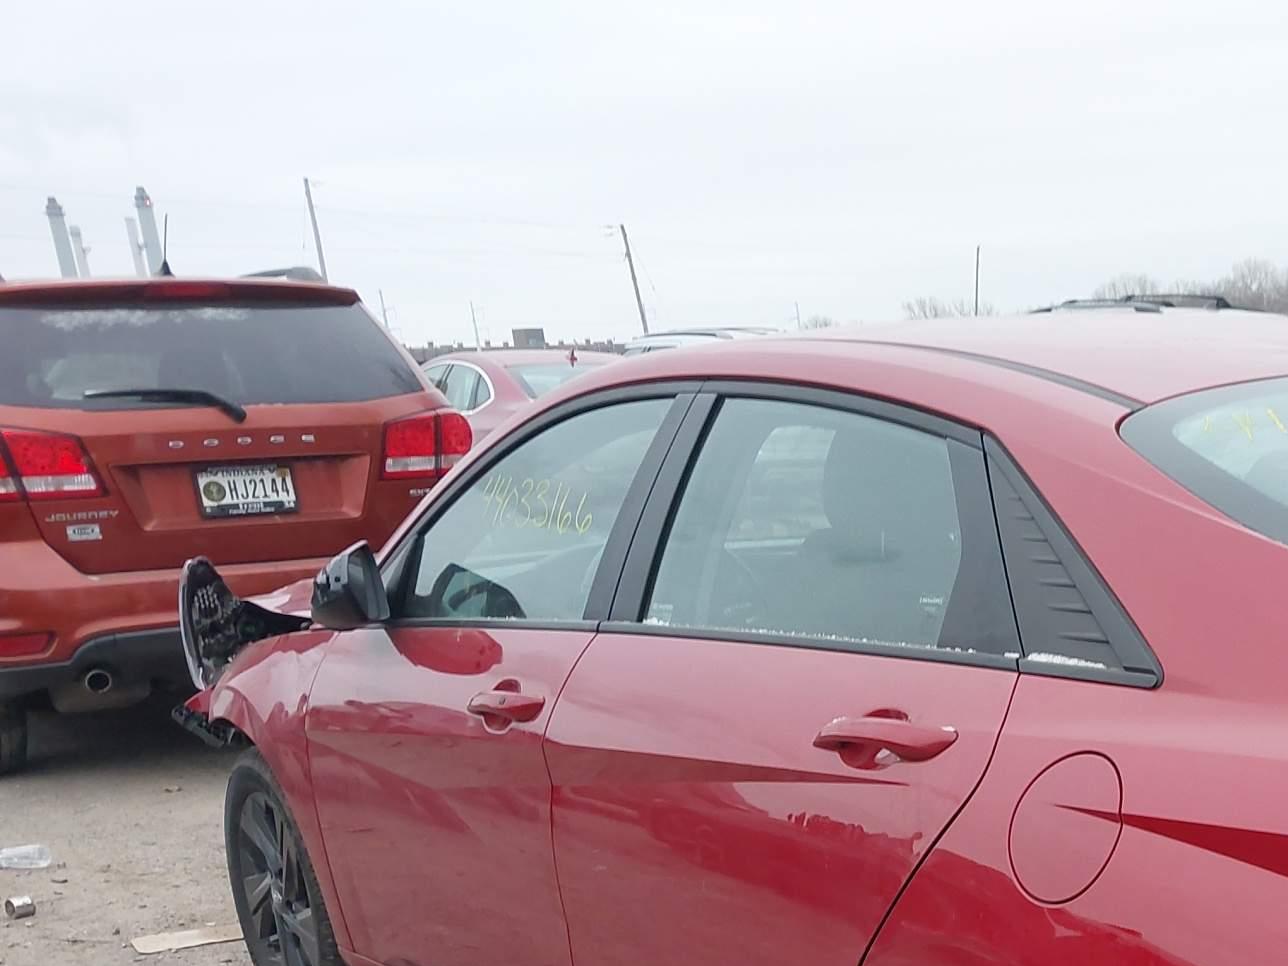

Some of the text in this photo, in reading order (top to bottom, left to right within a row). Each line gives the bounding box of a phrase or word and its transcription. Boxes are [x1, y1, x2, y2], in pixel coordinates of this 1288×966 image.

[169, 433, 315, 449] DODGE
[227, 478, 290, 501] HJ2144
[45, 509, 119, 523] JOURNEY
